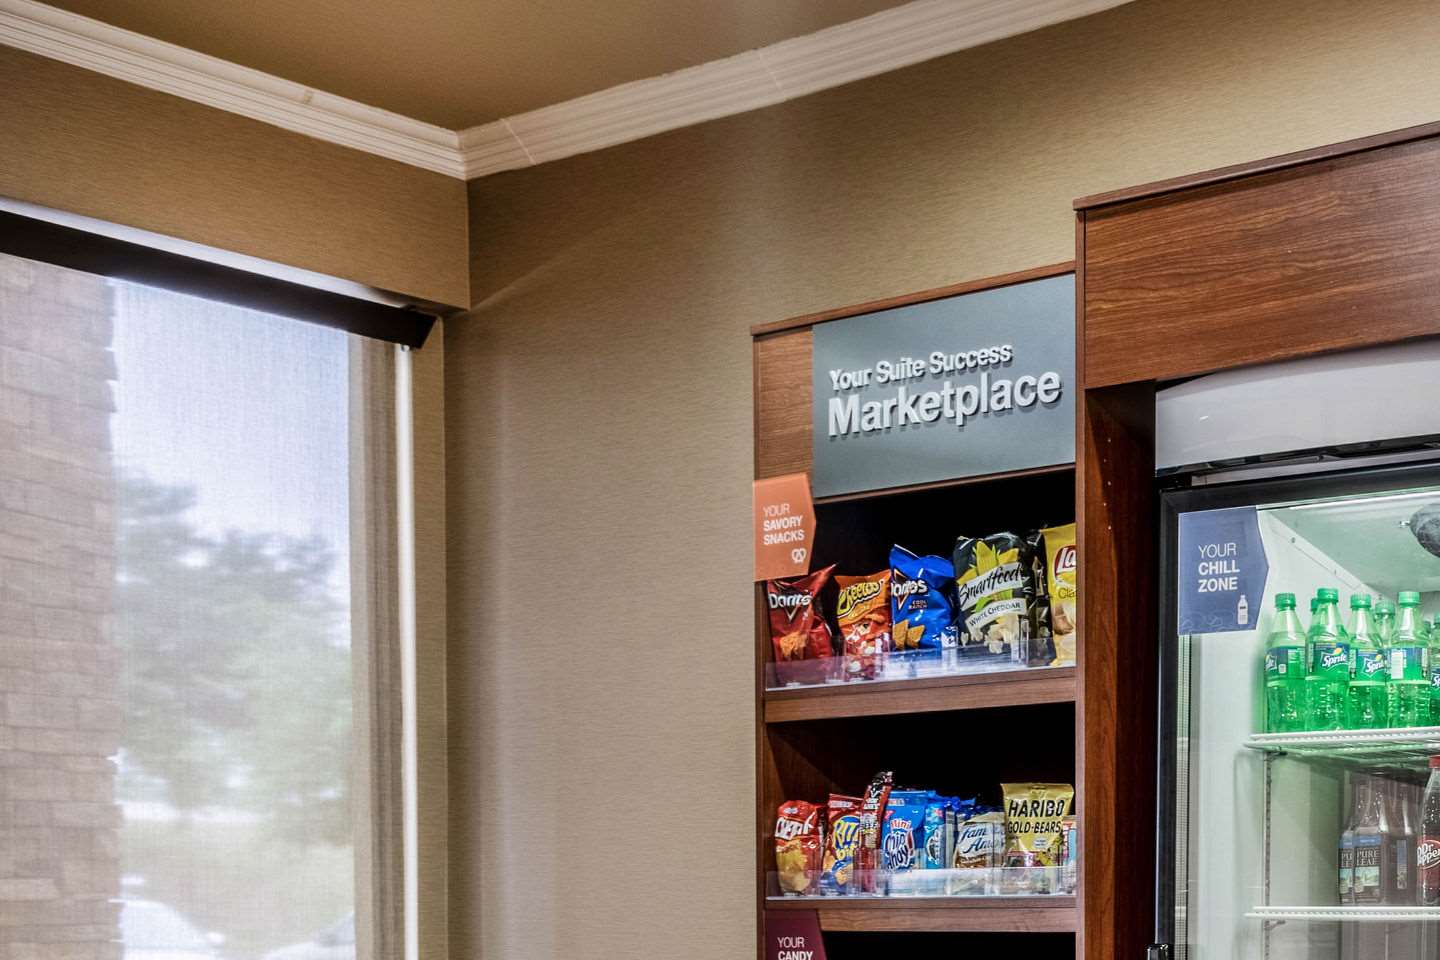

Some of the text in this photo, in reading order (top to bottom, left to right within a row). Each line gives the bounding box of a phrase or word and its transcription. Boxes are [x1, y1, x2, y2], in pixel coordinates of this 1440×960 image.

[829, 344, 1014, 391] Your Suite Success
[828, 370, 1062, 437] Marketplace
[763, 503, 790, 517] YOUR
[763, 515, 804, 532] SAVORY
[763, 529, 805, 546] SNACKS
[1198, 543, 1238, 559] YOUR
[1198, 560, 1241, 576] CHILL
[958, 563, 1025, 605] Smartfood
[1198, 577, 1238, 593] ZONE
[1008, 799, 1065, 818] HARIBO
[1357, 850, 1378, 858] PURE
[1422, 843, 1434, 853] Dr
[1357, 858, 1377, 866] LEAF
[777, 937, 805, 949] YOUR
